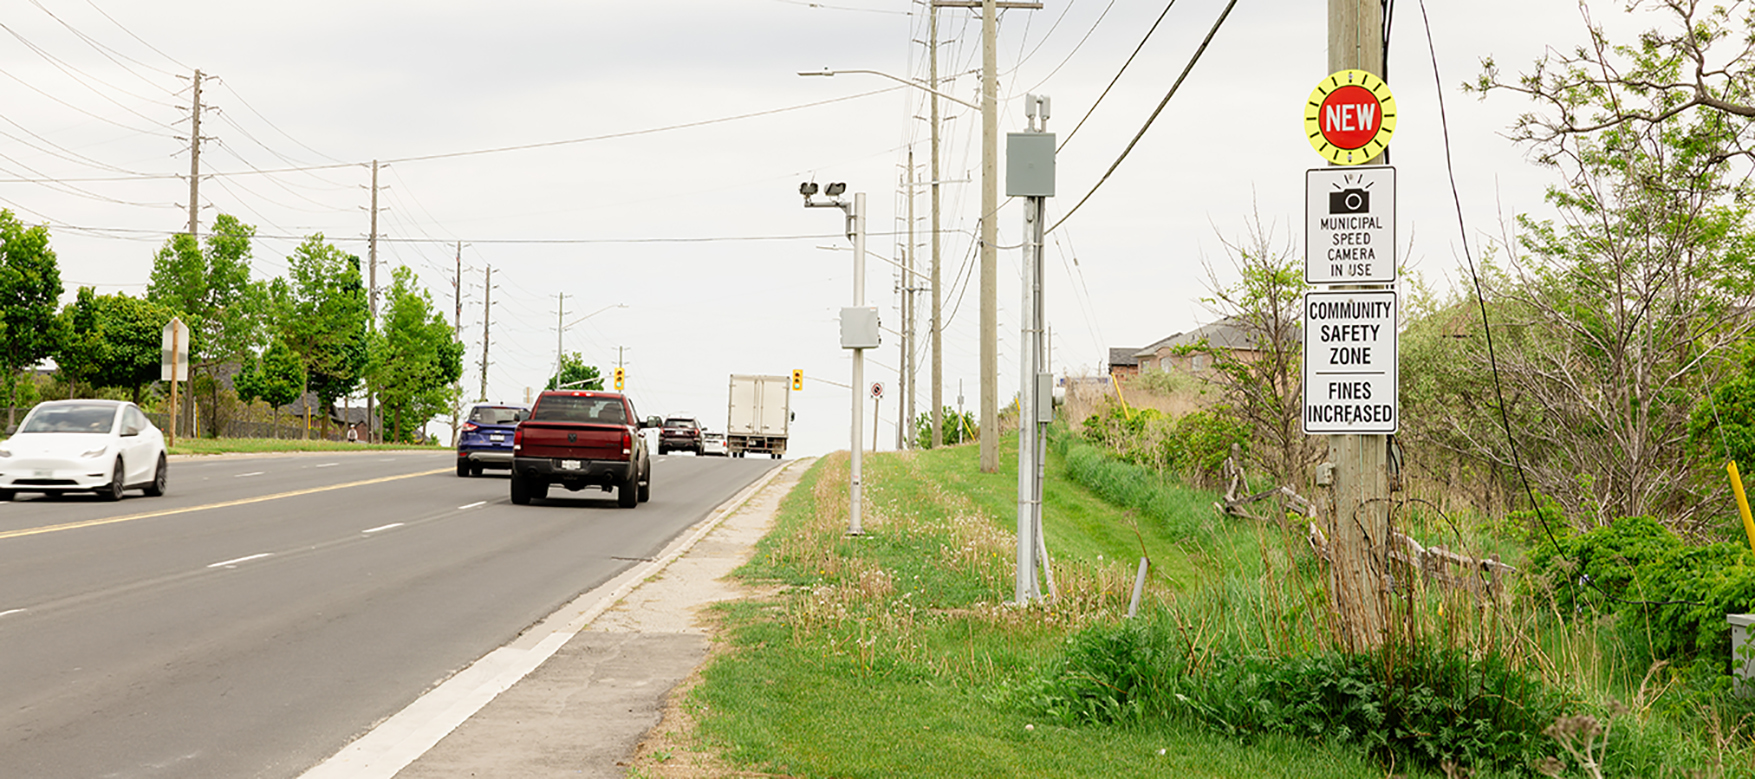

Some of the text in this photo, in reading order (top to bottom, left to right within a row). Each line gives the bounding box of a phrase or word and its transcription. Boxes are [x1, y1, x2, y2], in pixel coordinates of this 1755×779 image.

[1326, 103, 1375, 132] NEW
[1320, 217, 1382, 230] MUNICIPAL
[1332, 232, 1371, 245] SPEED
[1327, 248, 1375, 261] CAMERA
[1331, 263, 1372, 276] IN USE
[1309, 302, 1391, 319] COMMUNITY
[1321, 324, 1380, 342] SAFETY
[1330, 347, 1371, 364] ZONE
[1329, 382, 1371, 399] FINES
[1308, 405, 1392, 422] INCREASED
